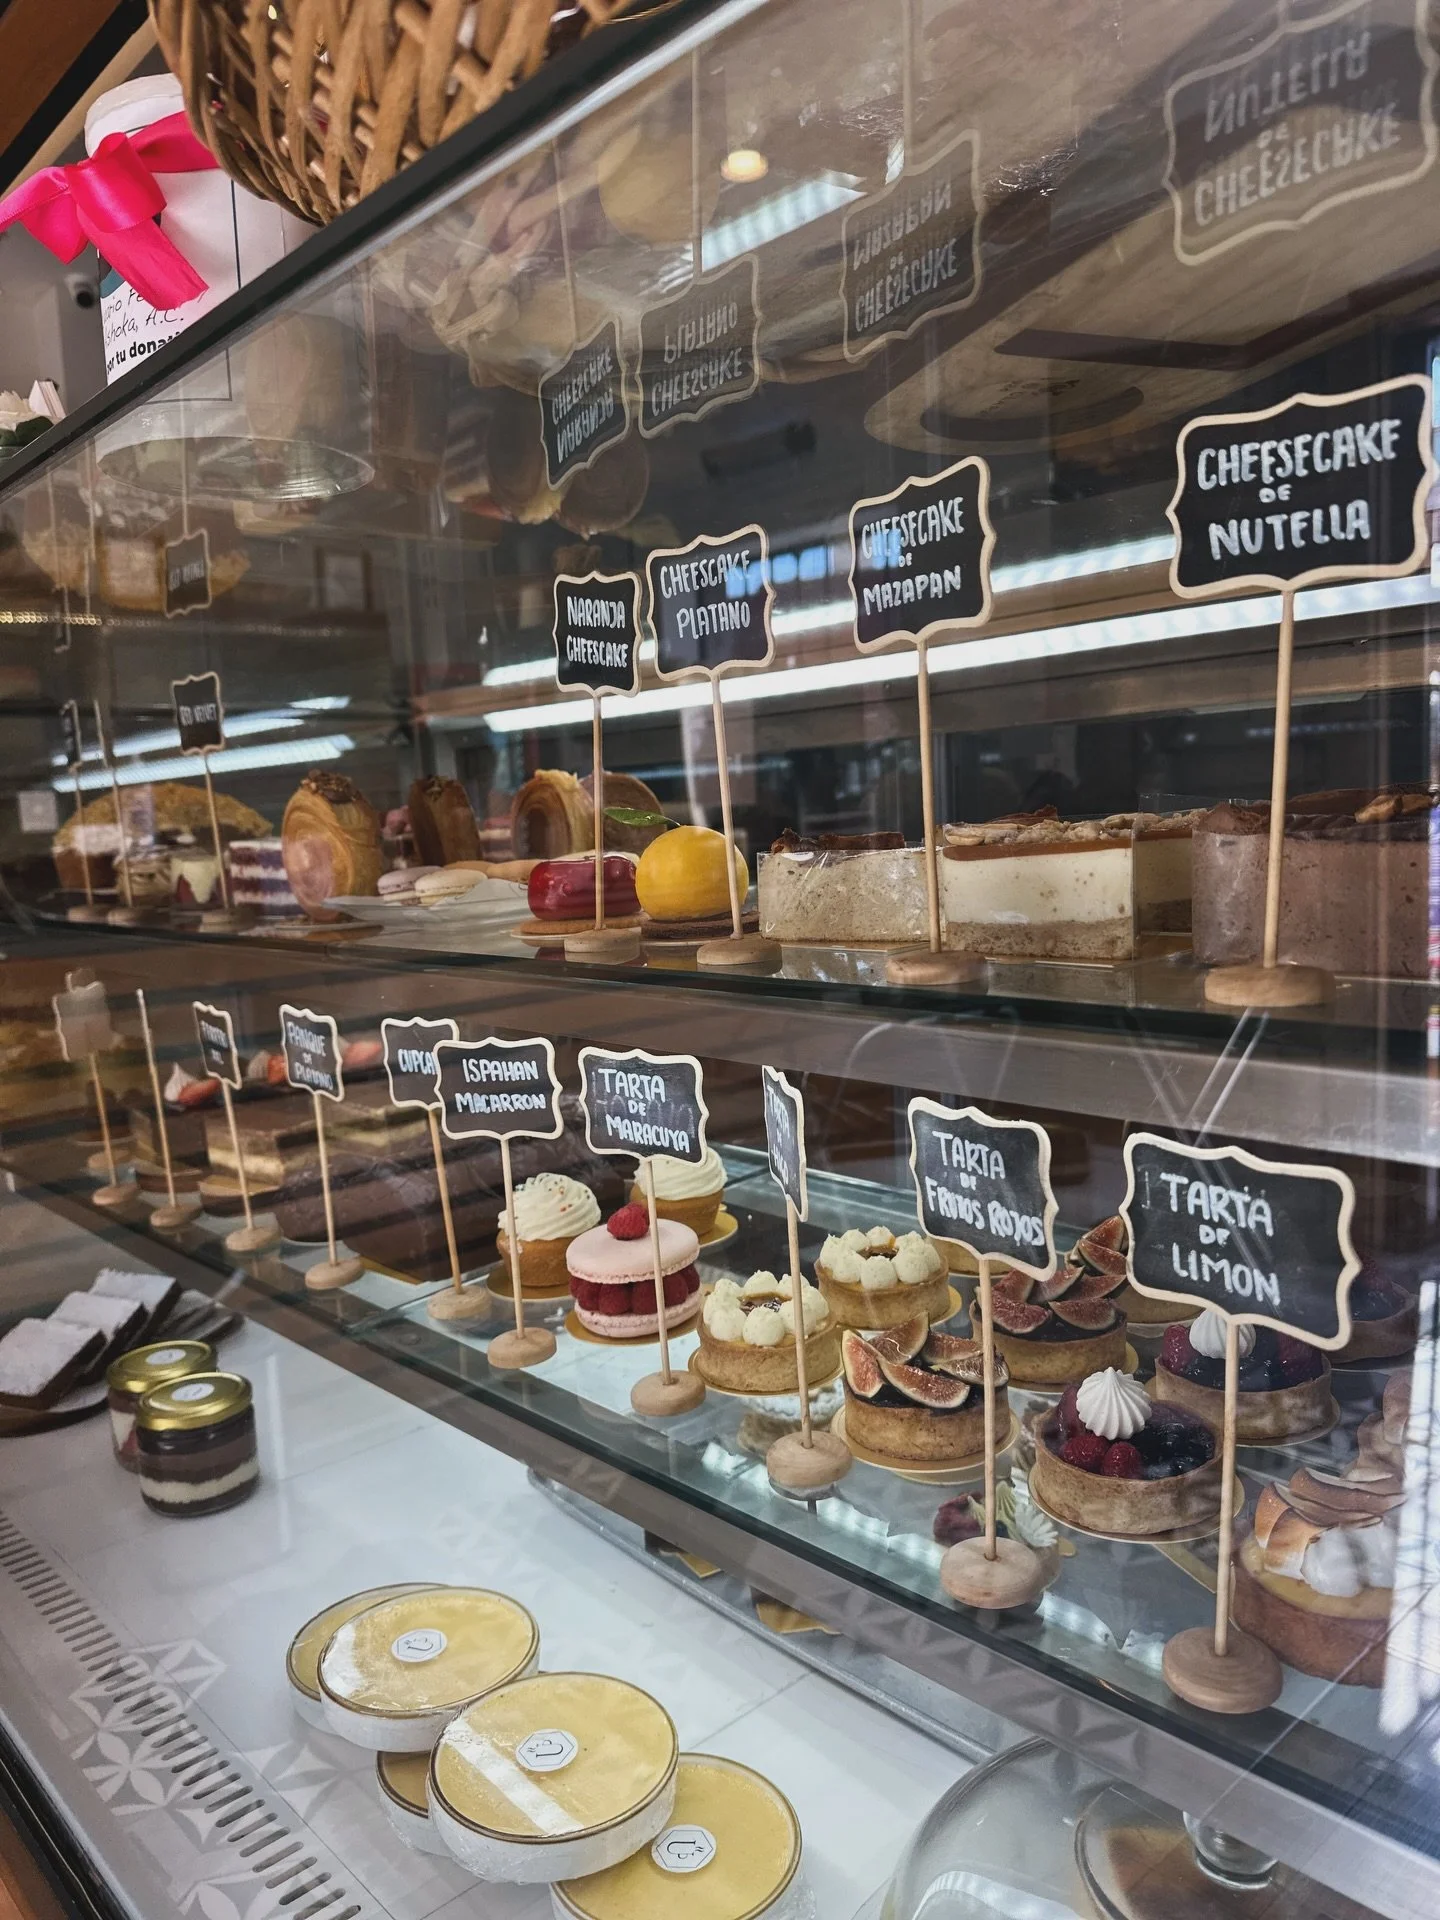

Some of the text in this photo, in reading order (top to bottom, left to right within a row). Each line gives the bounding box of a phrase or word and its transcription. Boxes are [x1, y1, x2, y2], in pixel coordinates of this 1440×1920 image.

[116, 349, 126, 365] tu
[1197, 418, 1401, 491] CHEESECAKE
[1258, 483, 1292, 503] DE
[861, 496, 965, 559] CHEESECAKE
[1208, 499, 1371, 561] NUTELLA
[660, 549, 750, 599] CHEESCAKE
[898, 552, 913, 567] DE
[862, 565, 961, 616] MAZAPAN
[567, 595, 625, 629] NARANJA
[676, 600, 750, 640] PLATANO
[566, 634, 629, 668] CHEESCAKE
[397, 1048, 438, 1076] CUPCA
[462, 1058, 539, 1083] ISPAHAN
[454, 1092, 547, 1114] MACARRON
[597, 1068, 666, 1103] TARTA
[627, 1100, 647, 1117] DE
[605, 1113, 690, 1153] MARACUYA
[932, 1130, 1006, 1180] TARTA
[959, 1172, 977, 1191] DE
[924, 1175, 1045, 1247] FRUTOS ROJOS
[1160, 1171, 1274, 1237] TARTA
[1198, 1224, 1231, 1247] DE
[1171, 1242, 1281, 1306] LIMON
